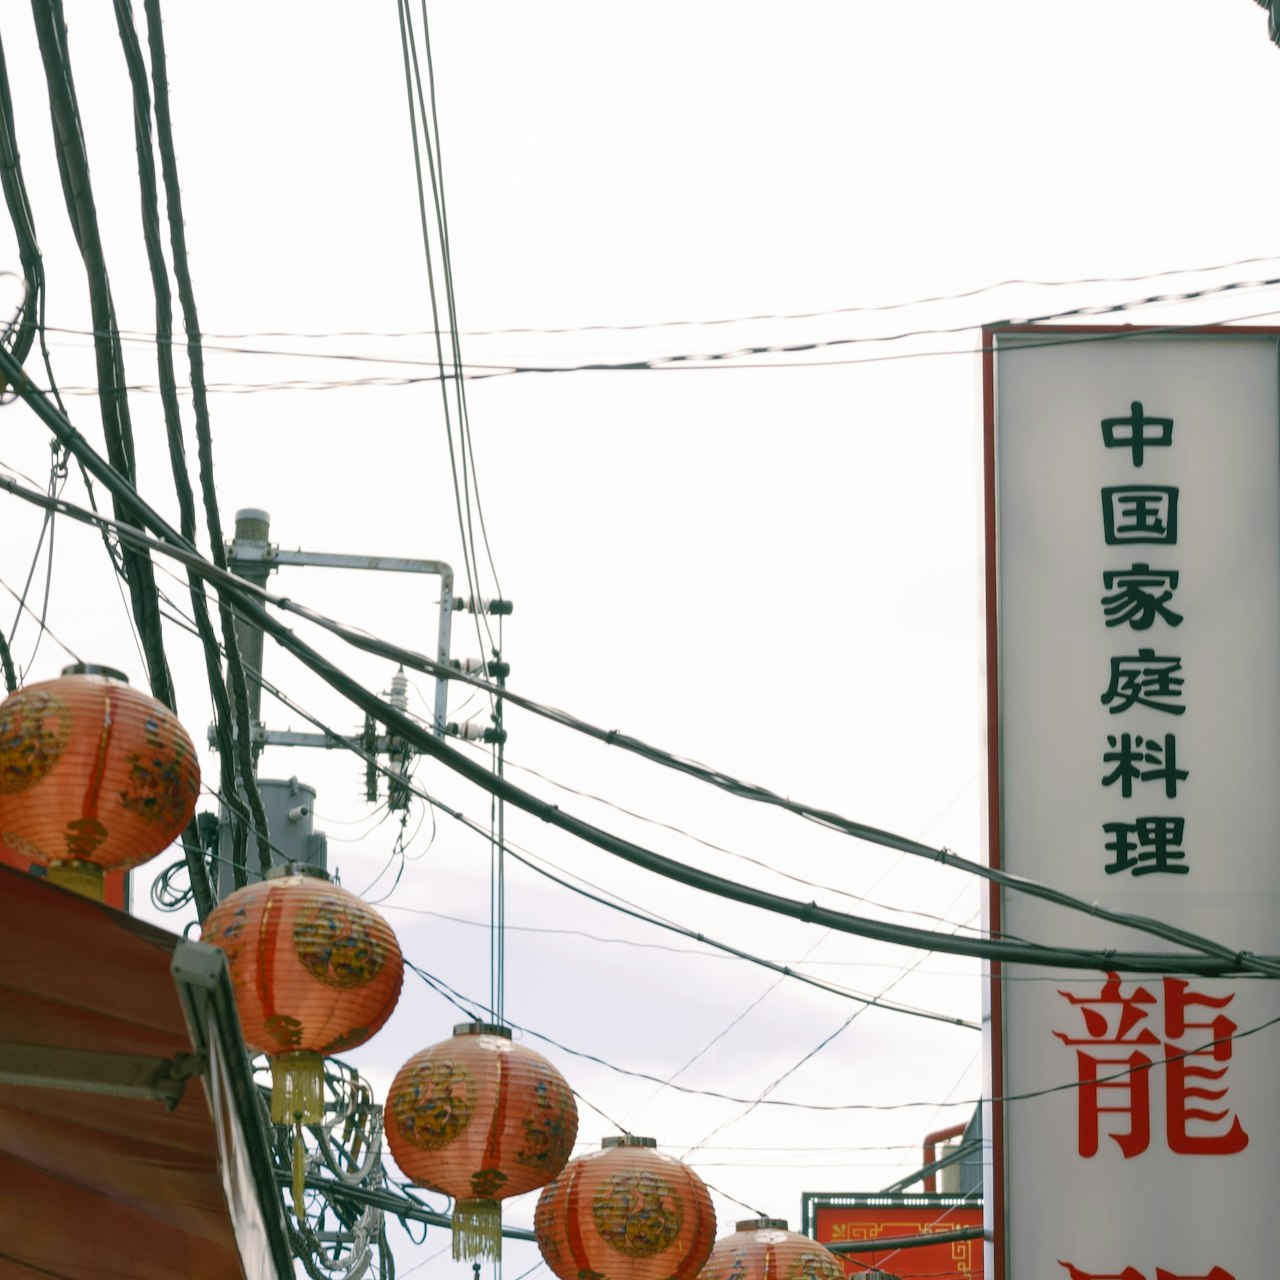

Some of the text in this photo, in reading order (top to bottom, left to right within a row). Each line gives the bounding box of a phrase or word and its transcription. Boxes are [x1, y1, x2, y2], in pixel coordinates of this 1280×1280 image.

[1101, 401, 1190, 877] 中国家庭料理
